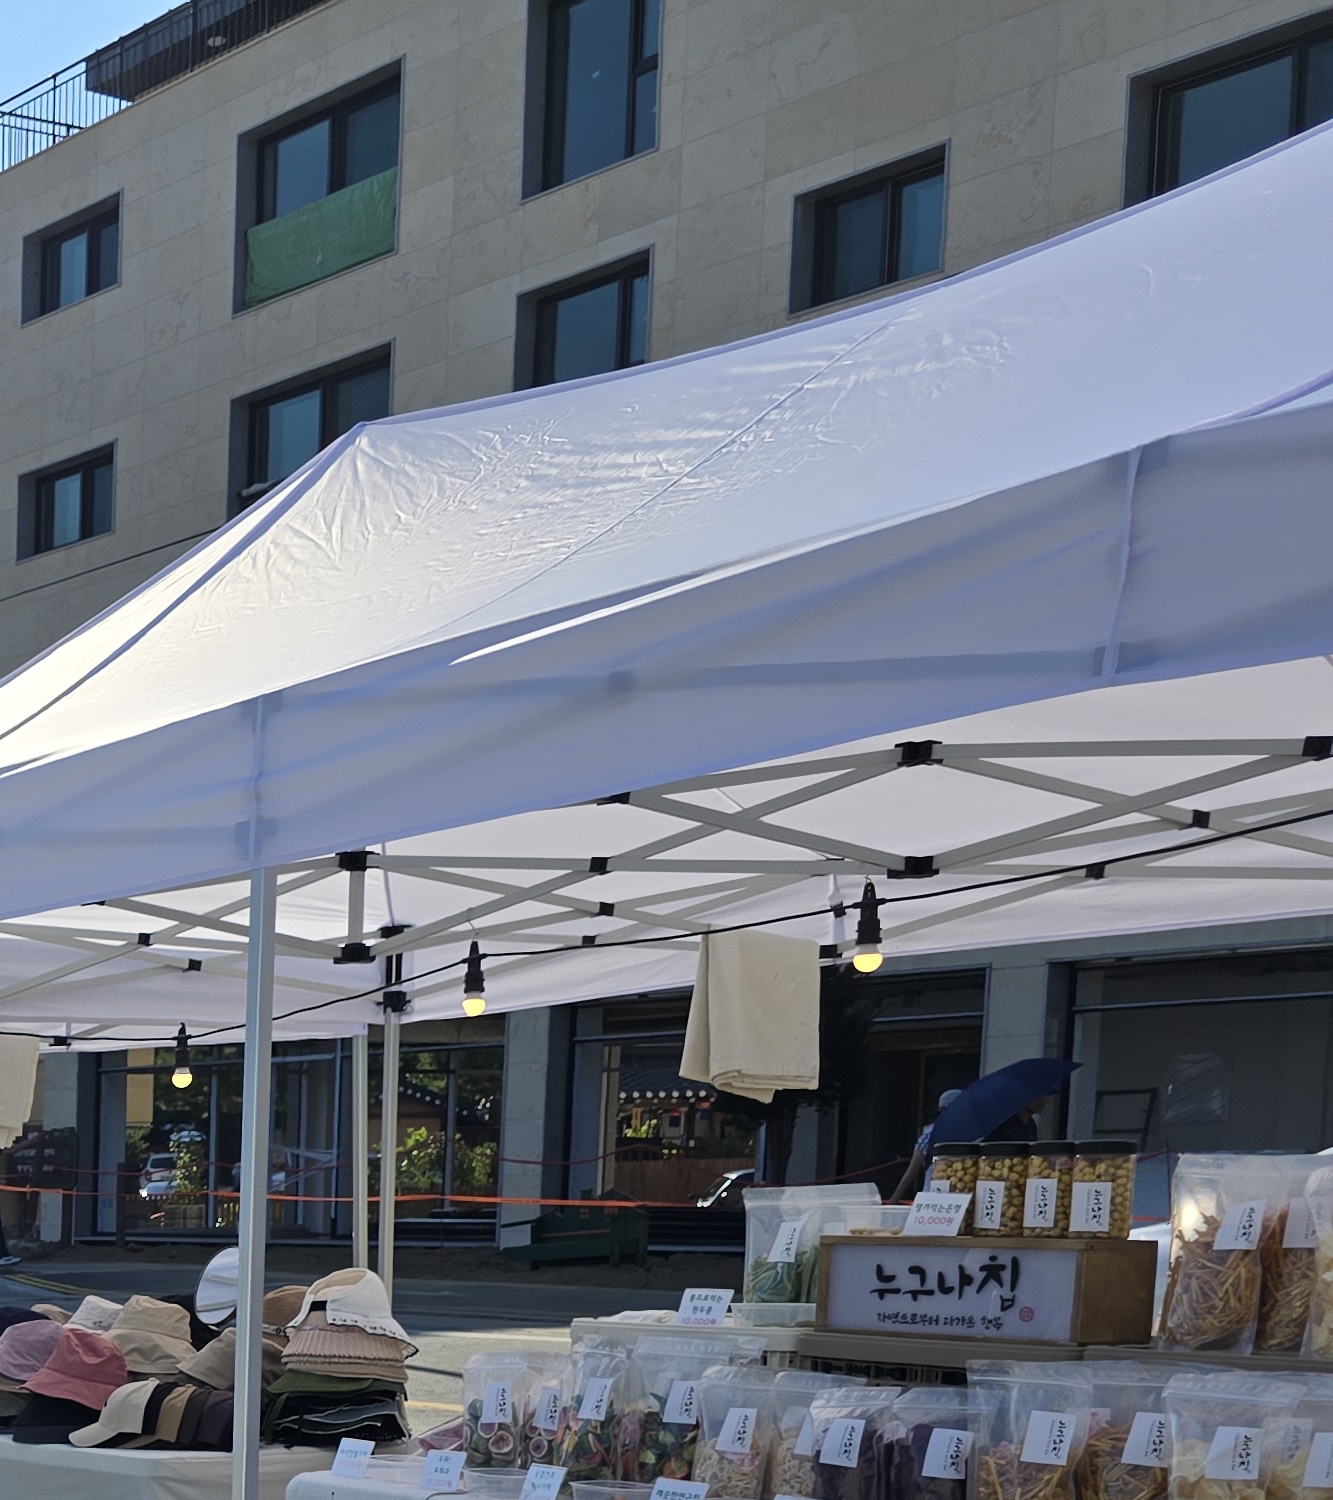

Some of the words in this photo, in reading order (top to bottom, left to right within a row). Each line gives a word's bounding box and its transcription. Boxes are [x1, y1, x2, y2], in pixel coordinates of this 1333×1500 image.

[1091, 1188, 1104, 1224] 누구나칩
[869, 1255, 1020, 1312] 누구나칩
[876, 1311, 940, 1328] 자연으로부터
